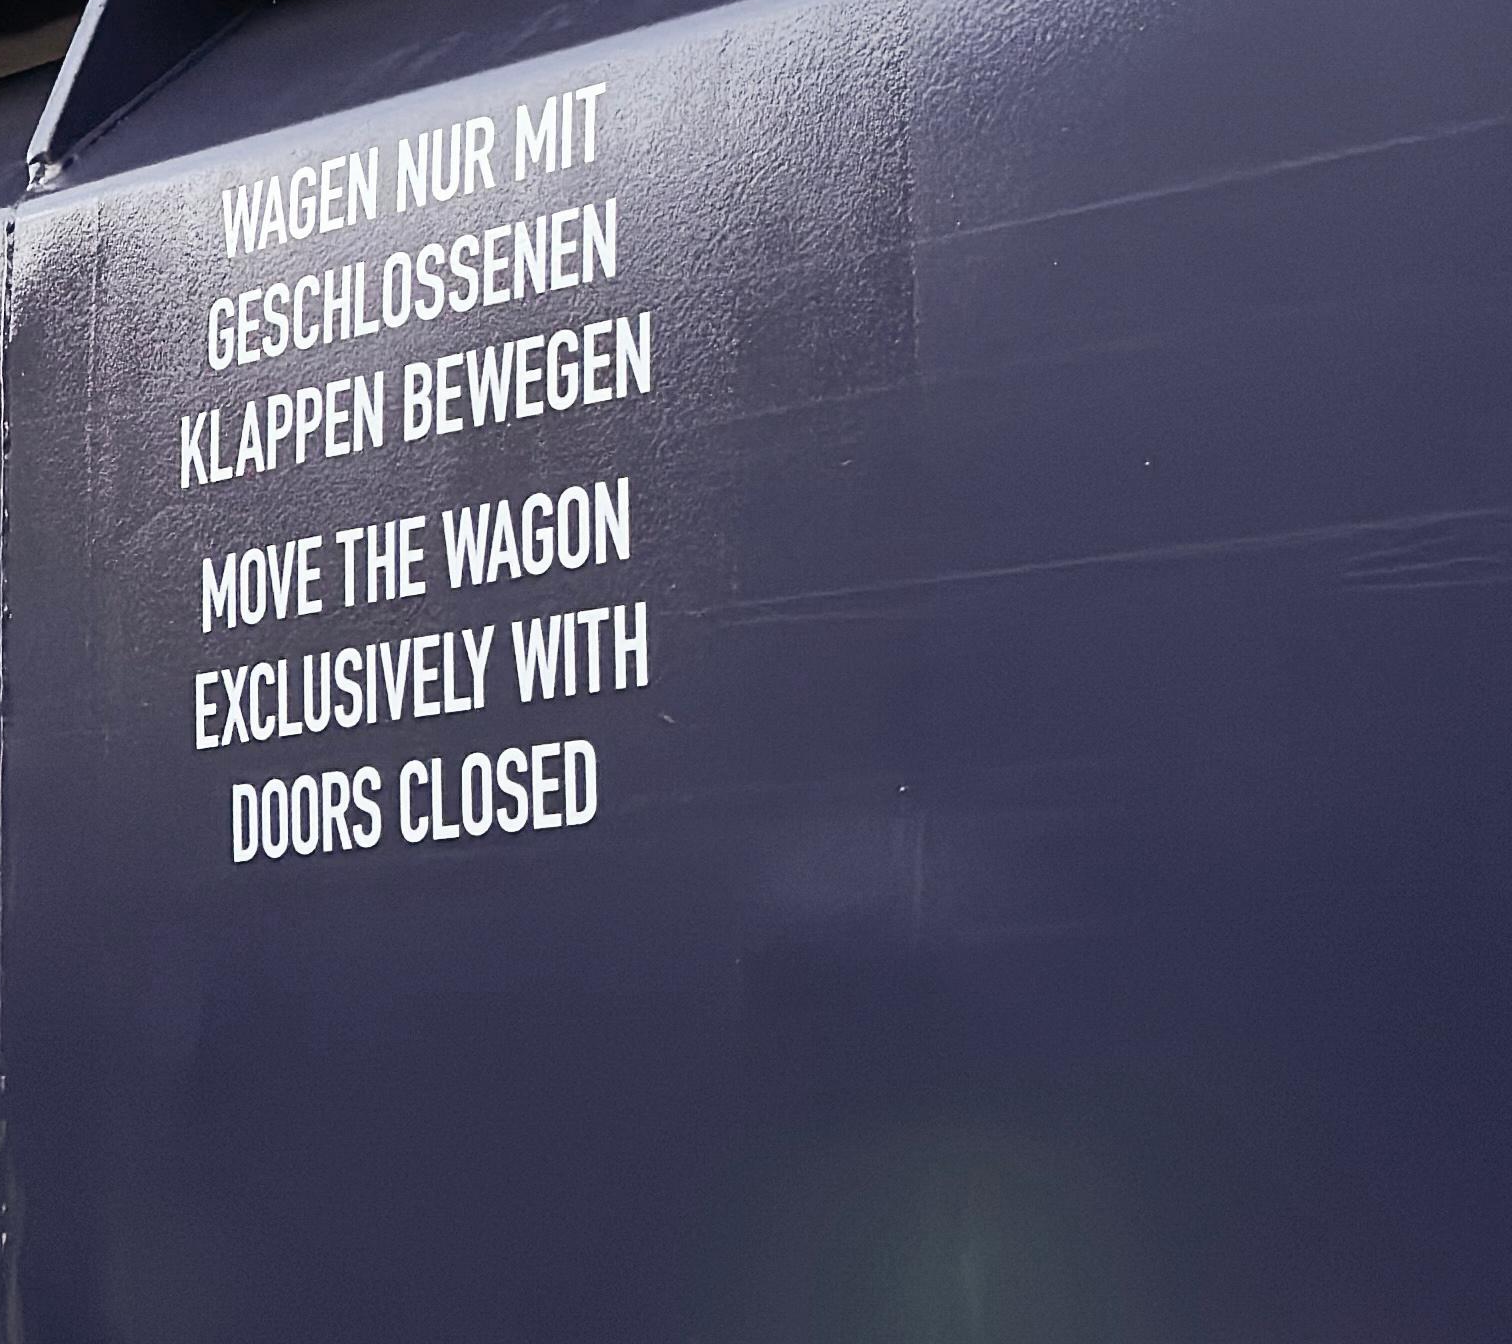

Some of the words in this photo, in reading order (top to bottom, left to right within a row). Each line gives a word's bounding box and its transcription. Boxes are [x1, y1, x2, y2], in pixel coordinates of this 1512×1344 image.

[221, 146, 379, 259] WAGEN
[396, 116, 496, 212] NUR
[515, 82, 606, 183] MIT
[207, 198, 617, 370] GESCHLOSSENEN
[180, 371, 384, 488] KLAPPEN
[403, 312, 650, 442] BEWEGEN
[202, 536, 322, 632] MOVE
[336, 516, 426, 607] THE
[442, 477, 630, 589] WAGON
[195, 625, 495, 750] EXCLUSIVELY
[512, 602, 648, 703] WITH
[232, 765, 381, 862] DOORS
[400, 740, 597, 843] CLOSED
